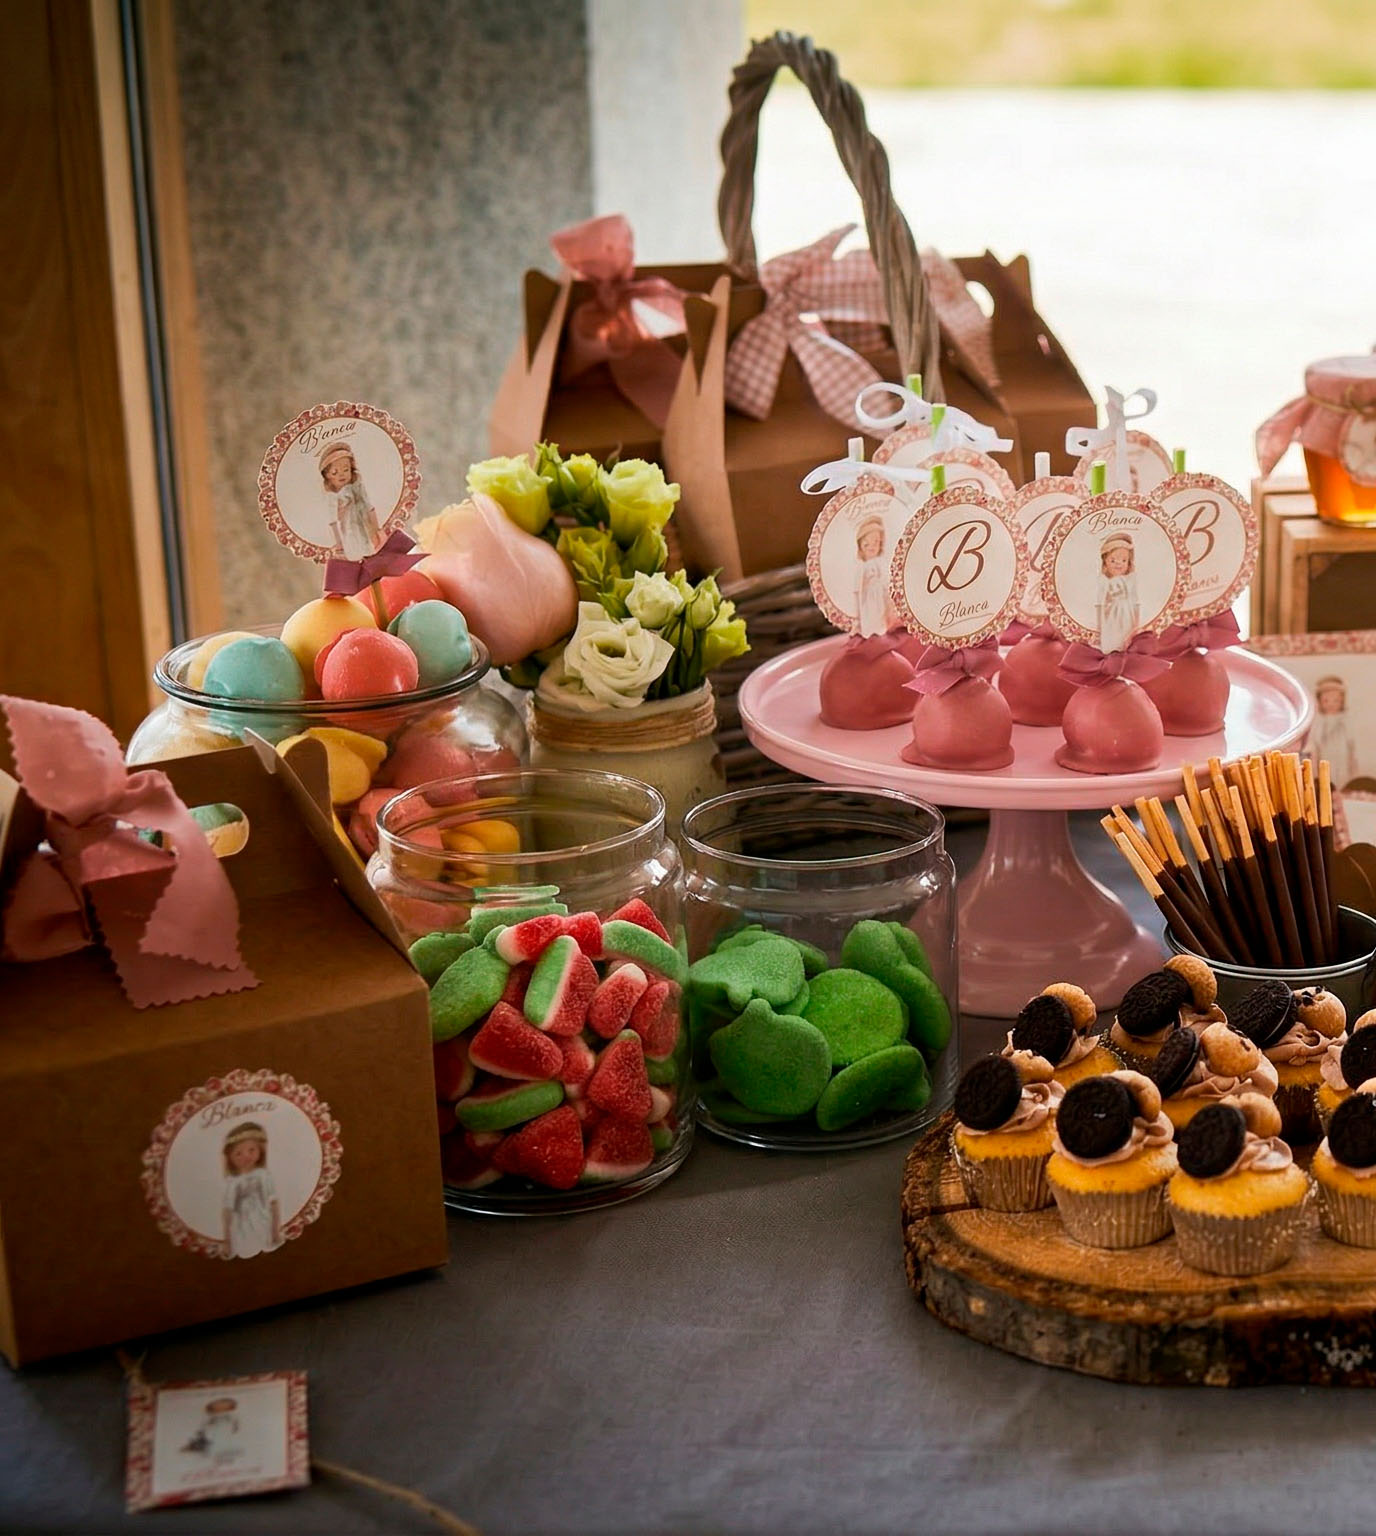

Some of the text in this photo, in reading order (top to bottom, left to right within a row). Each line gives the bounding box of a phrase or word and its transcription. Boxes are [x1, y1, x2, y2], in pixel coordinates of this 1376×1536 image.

[1089, 510, 1143, 534] Blanca
[927, 520, 992, 594] B
[939, 599, 990, 629] Blanca
[201, 1100, 277, 1129] Blanca
